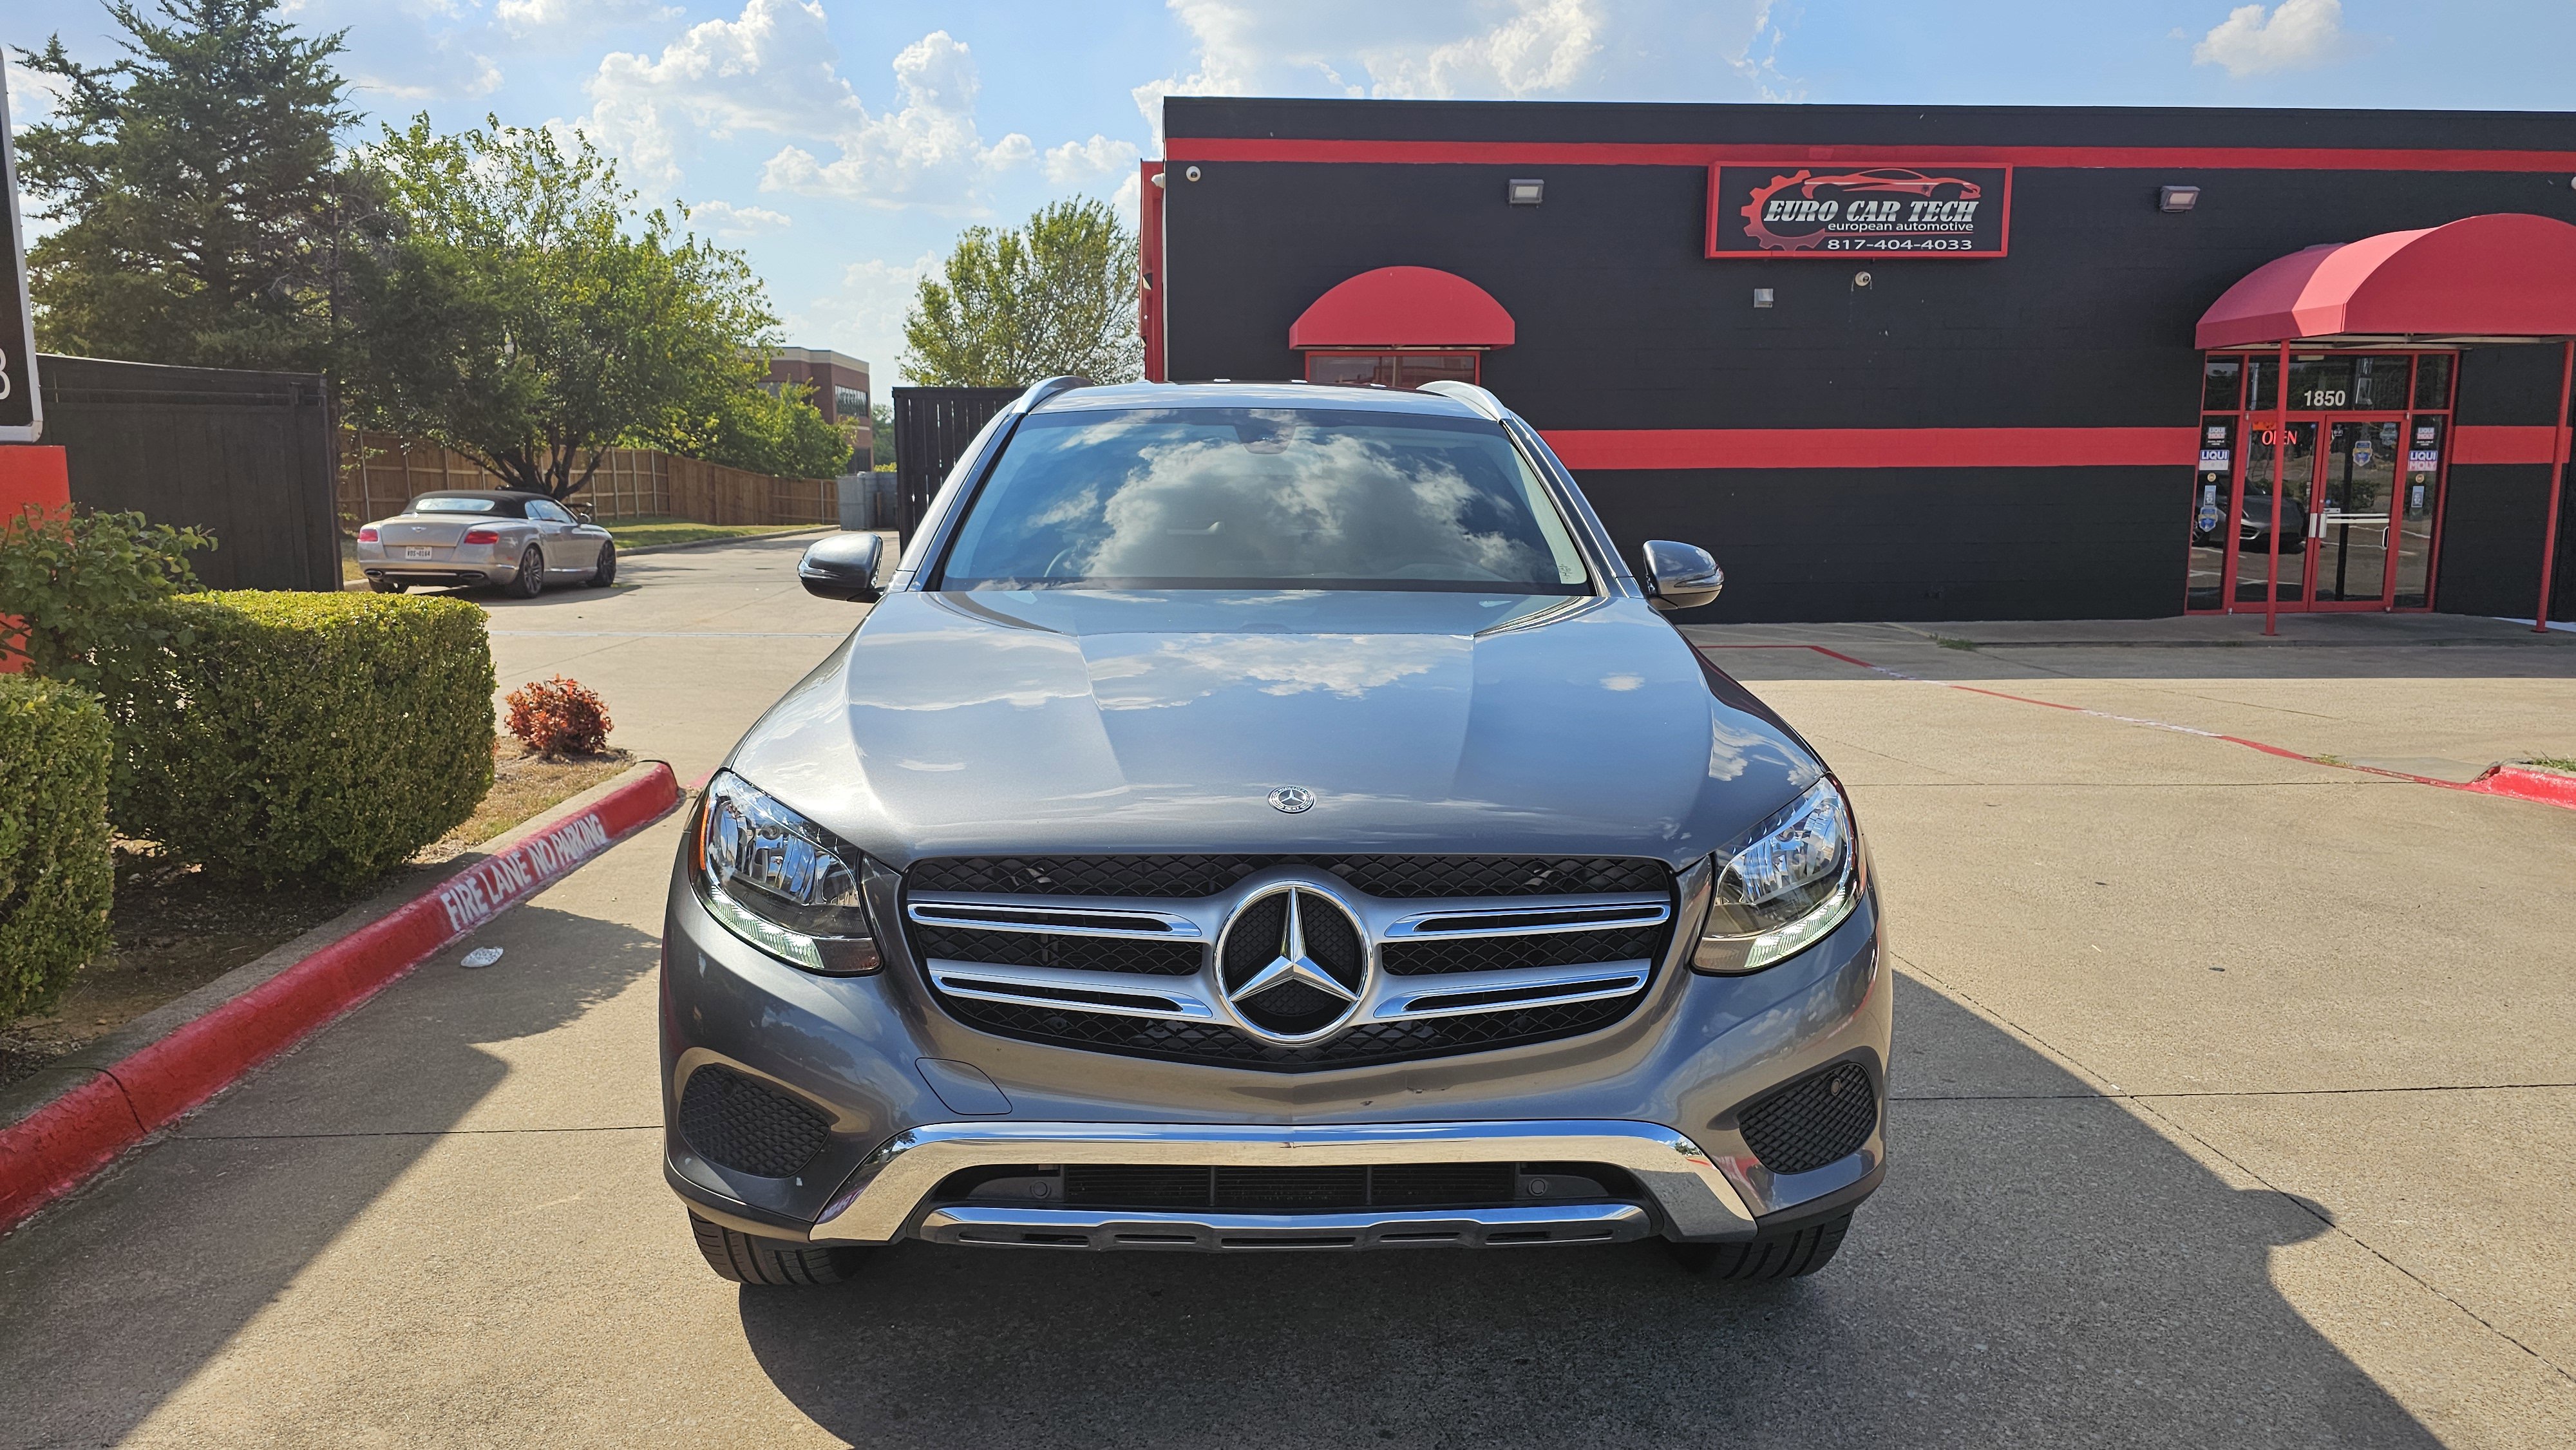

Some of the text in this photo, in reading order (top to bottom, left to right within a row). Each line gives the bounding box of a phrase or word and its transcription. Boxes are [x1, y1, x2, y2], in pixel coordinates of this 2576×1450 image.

[1763, 201, 1980, 221] EURO CAR TECH
[1828, 222, 1974, 232] european automotive
[1827, 240, 1973, 250] 817-404-4033
[2304, 390, 2345, 406] 1850
[2201, 450, 2228, 460] LIQUI
[2410, 451, 2436, 460] LIQUI
[2409, 461, 2436, 469] MOLY
[440, 813, 608, 932] FIRE LANE NO PARKING
